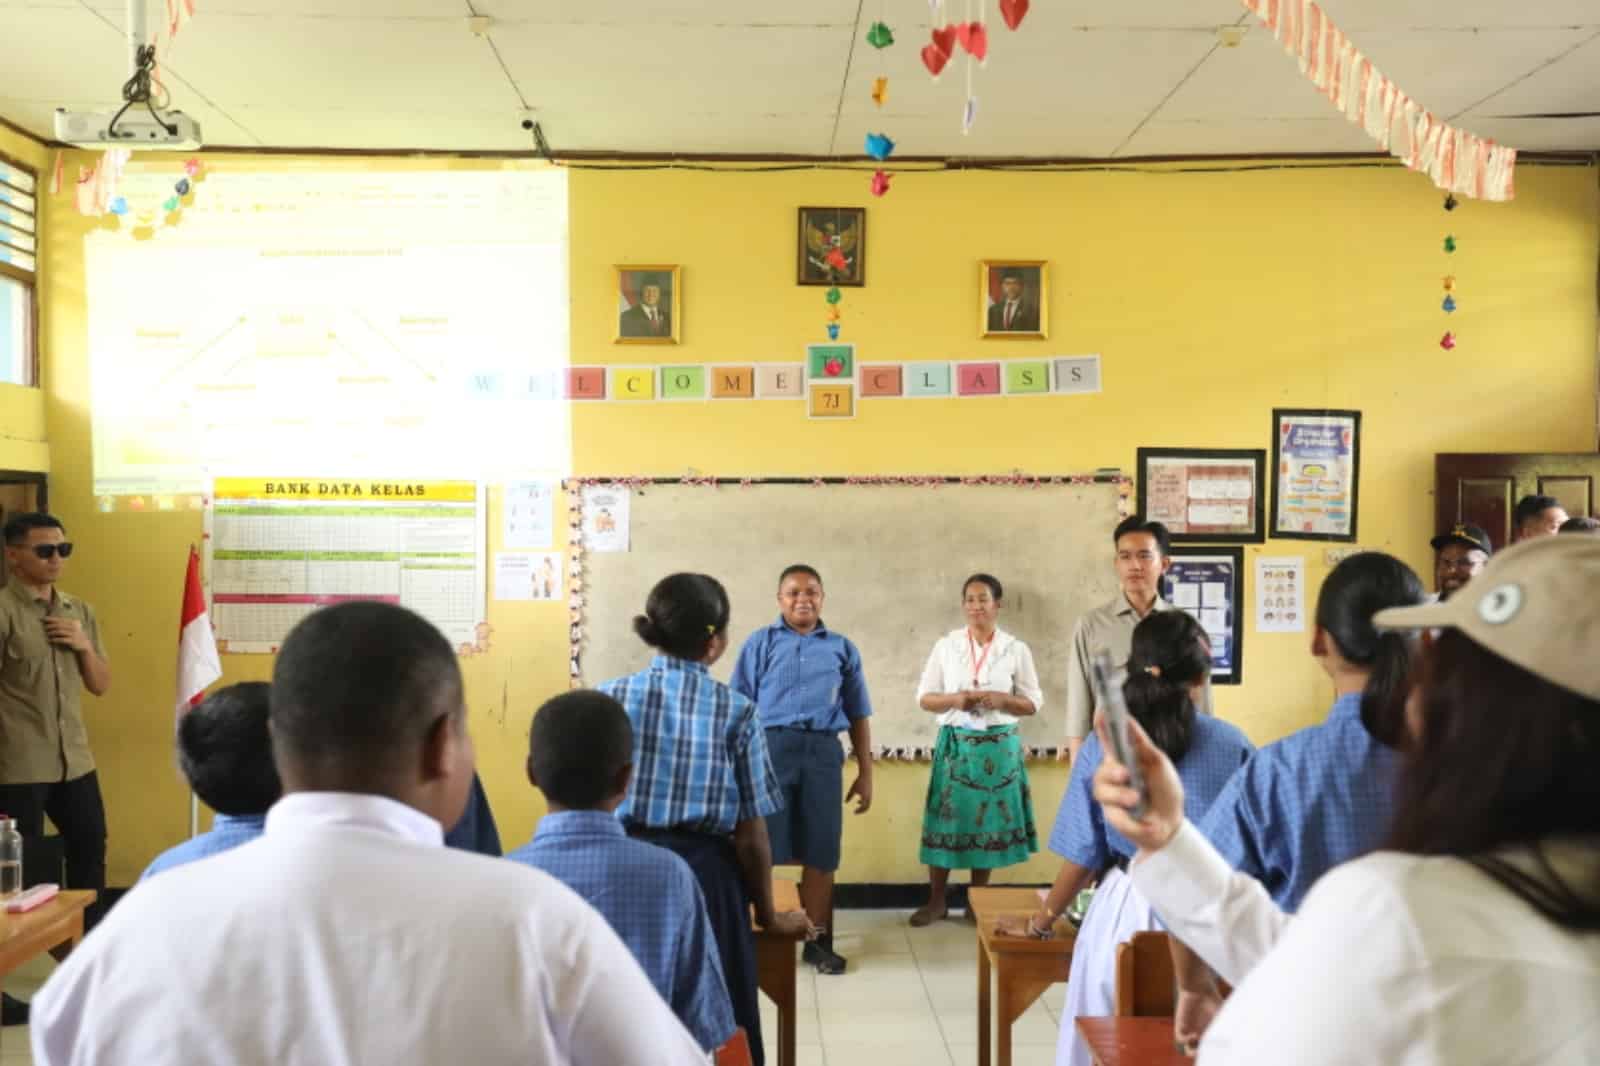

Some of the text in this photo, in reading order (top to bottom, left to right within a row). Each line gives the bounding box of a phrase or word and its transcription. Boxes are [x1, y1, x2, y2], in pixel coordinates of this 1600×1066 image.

[474, 372, 787, 393] WELCOME
[873, 366, 1082, 390] CLASS
[822, 392, 840, 409] 7J
[265, 482, 425, 497] BANK DATA KELAS
